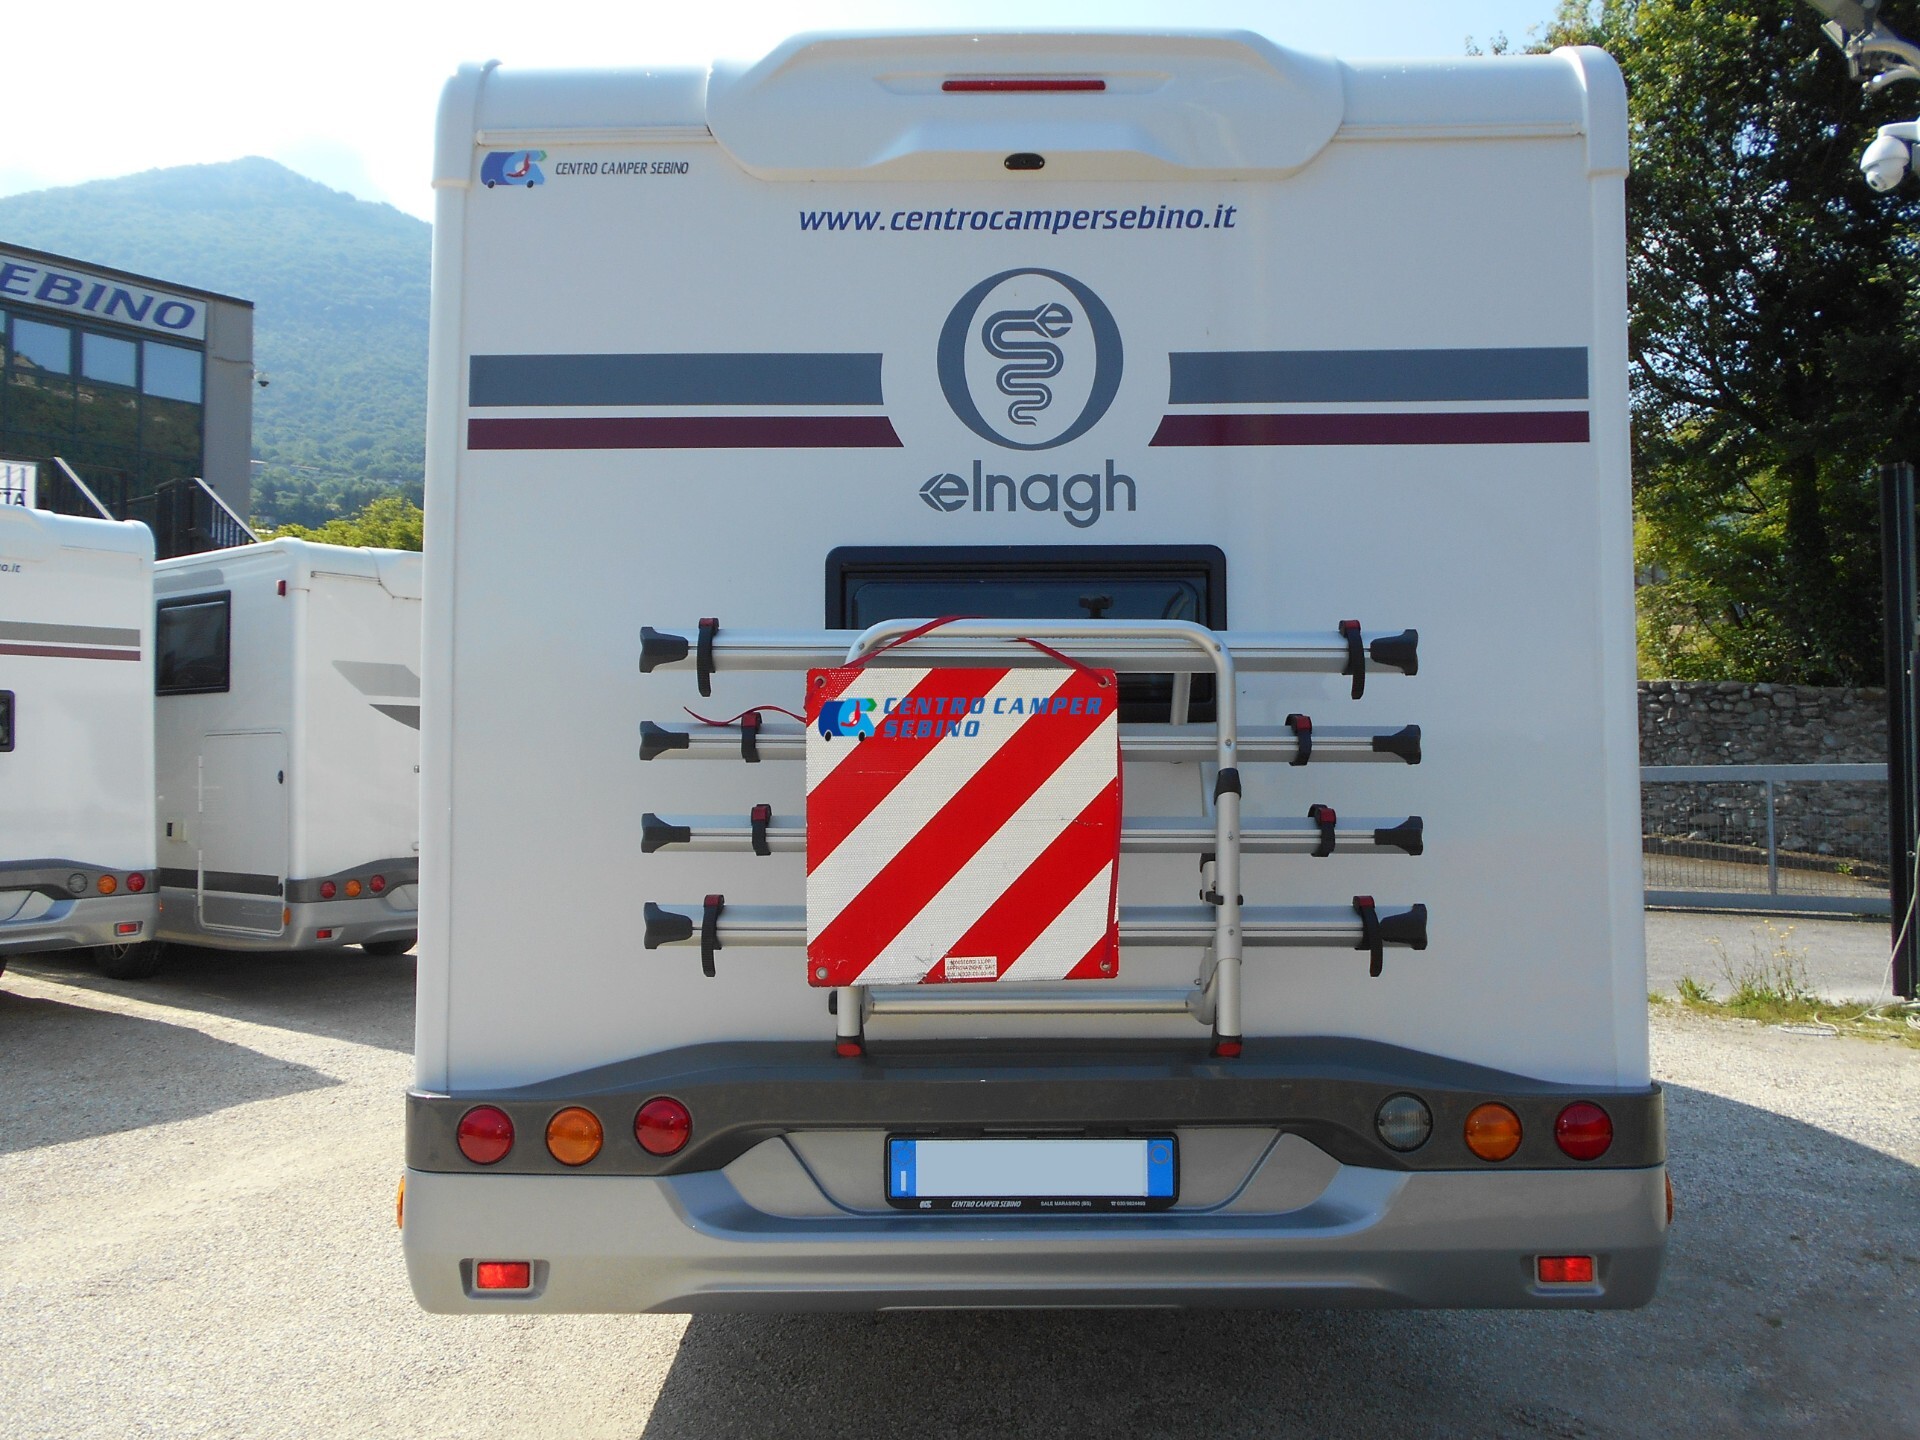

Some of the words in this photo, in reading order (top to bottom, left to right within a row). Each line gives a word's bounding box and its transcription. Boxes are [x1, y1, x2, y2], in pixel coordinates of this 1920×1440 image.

[555, 162, 598, 175] CENTRO
[601, 162, 648, 175] CAMPER
[650, 161, 689, 175] SEBINO
[798, 203, 1237, 235] www.centrocampersebino.it
[918, 458, 1137, 529] elnagh
[883, 697, 985, 715] CENTRO
[993, 697, 1103, 715] CAMPER
[883, 720, 980, 738] SEBINO
[951, 1200, 975, 1208] CENTRO
[975, 1200, 999, 1208] CAMPER
[999, 1200, 1022, 1208] SEBINO
